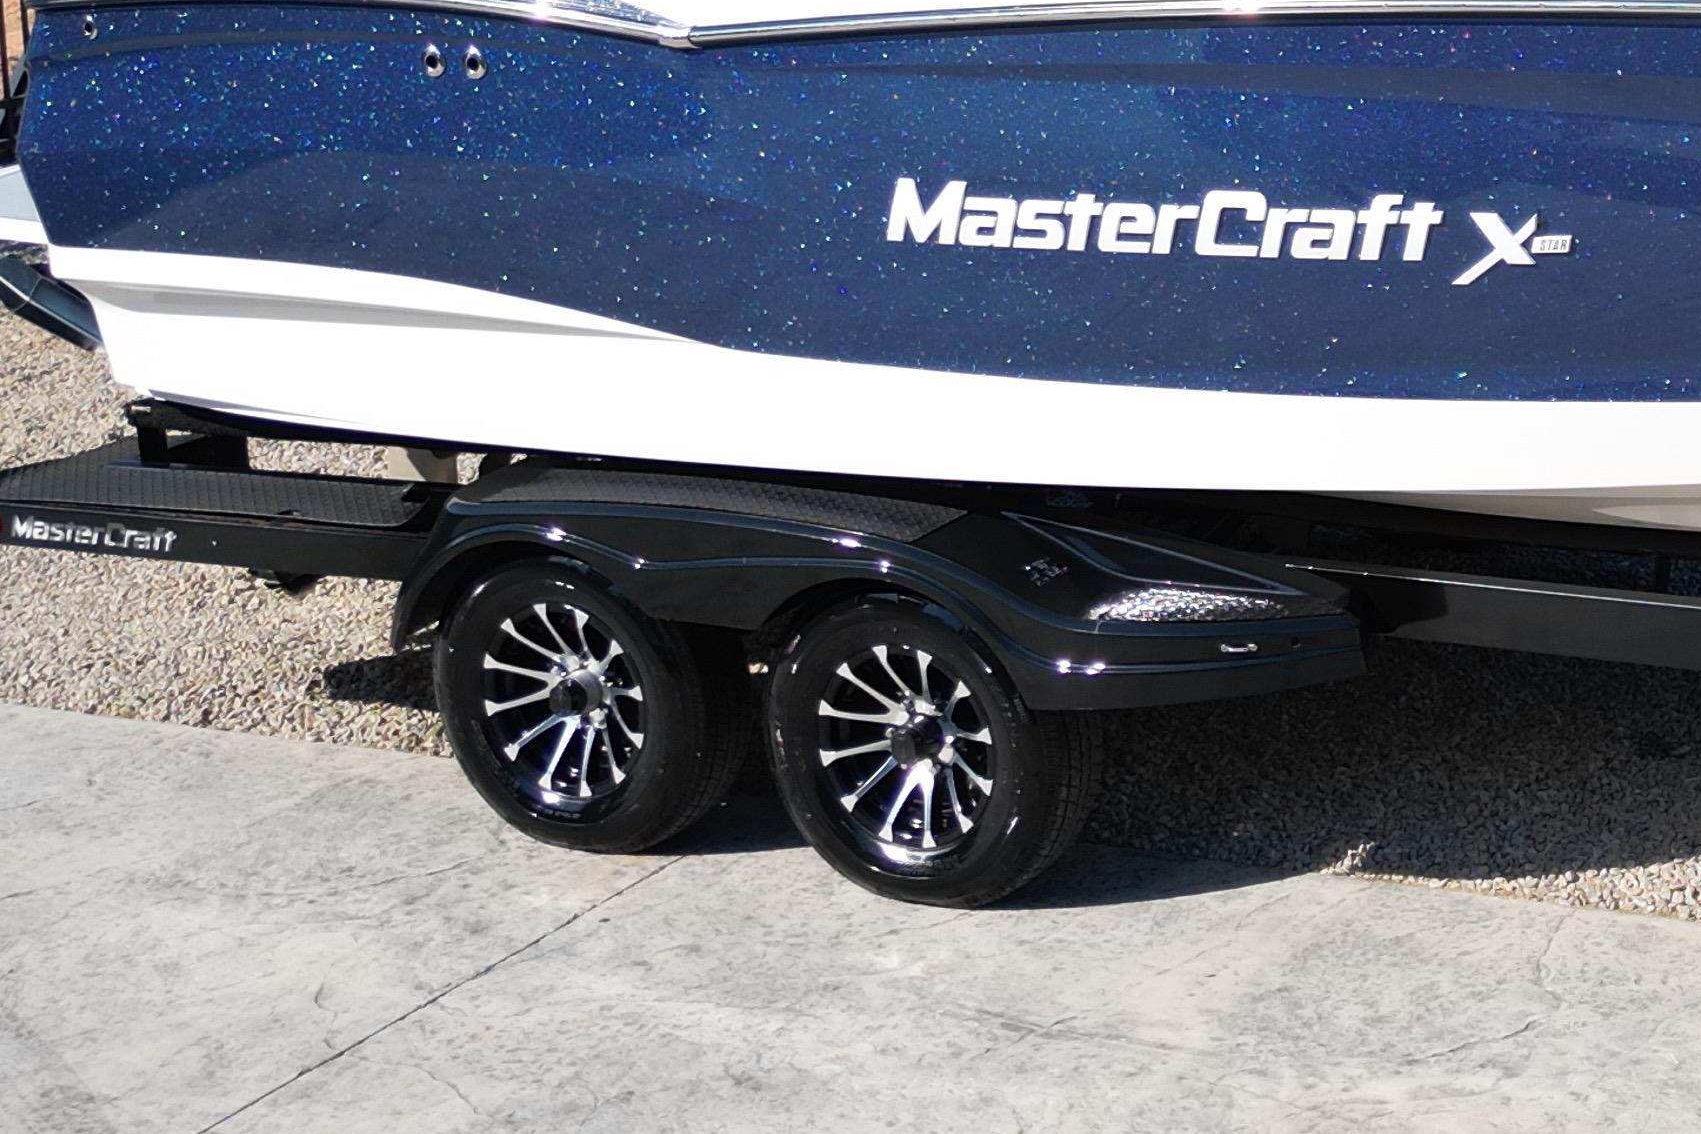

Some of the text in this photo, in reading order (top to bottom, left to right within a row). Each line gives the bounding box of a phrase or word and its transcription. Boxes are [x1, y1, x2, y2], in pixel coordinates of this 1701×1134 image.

[886, 177, 1444, 262] MasterCraft
[1539, 239, 1568, 252] STAR
[11, 514, 178, 553] MasterCraft
